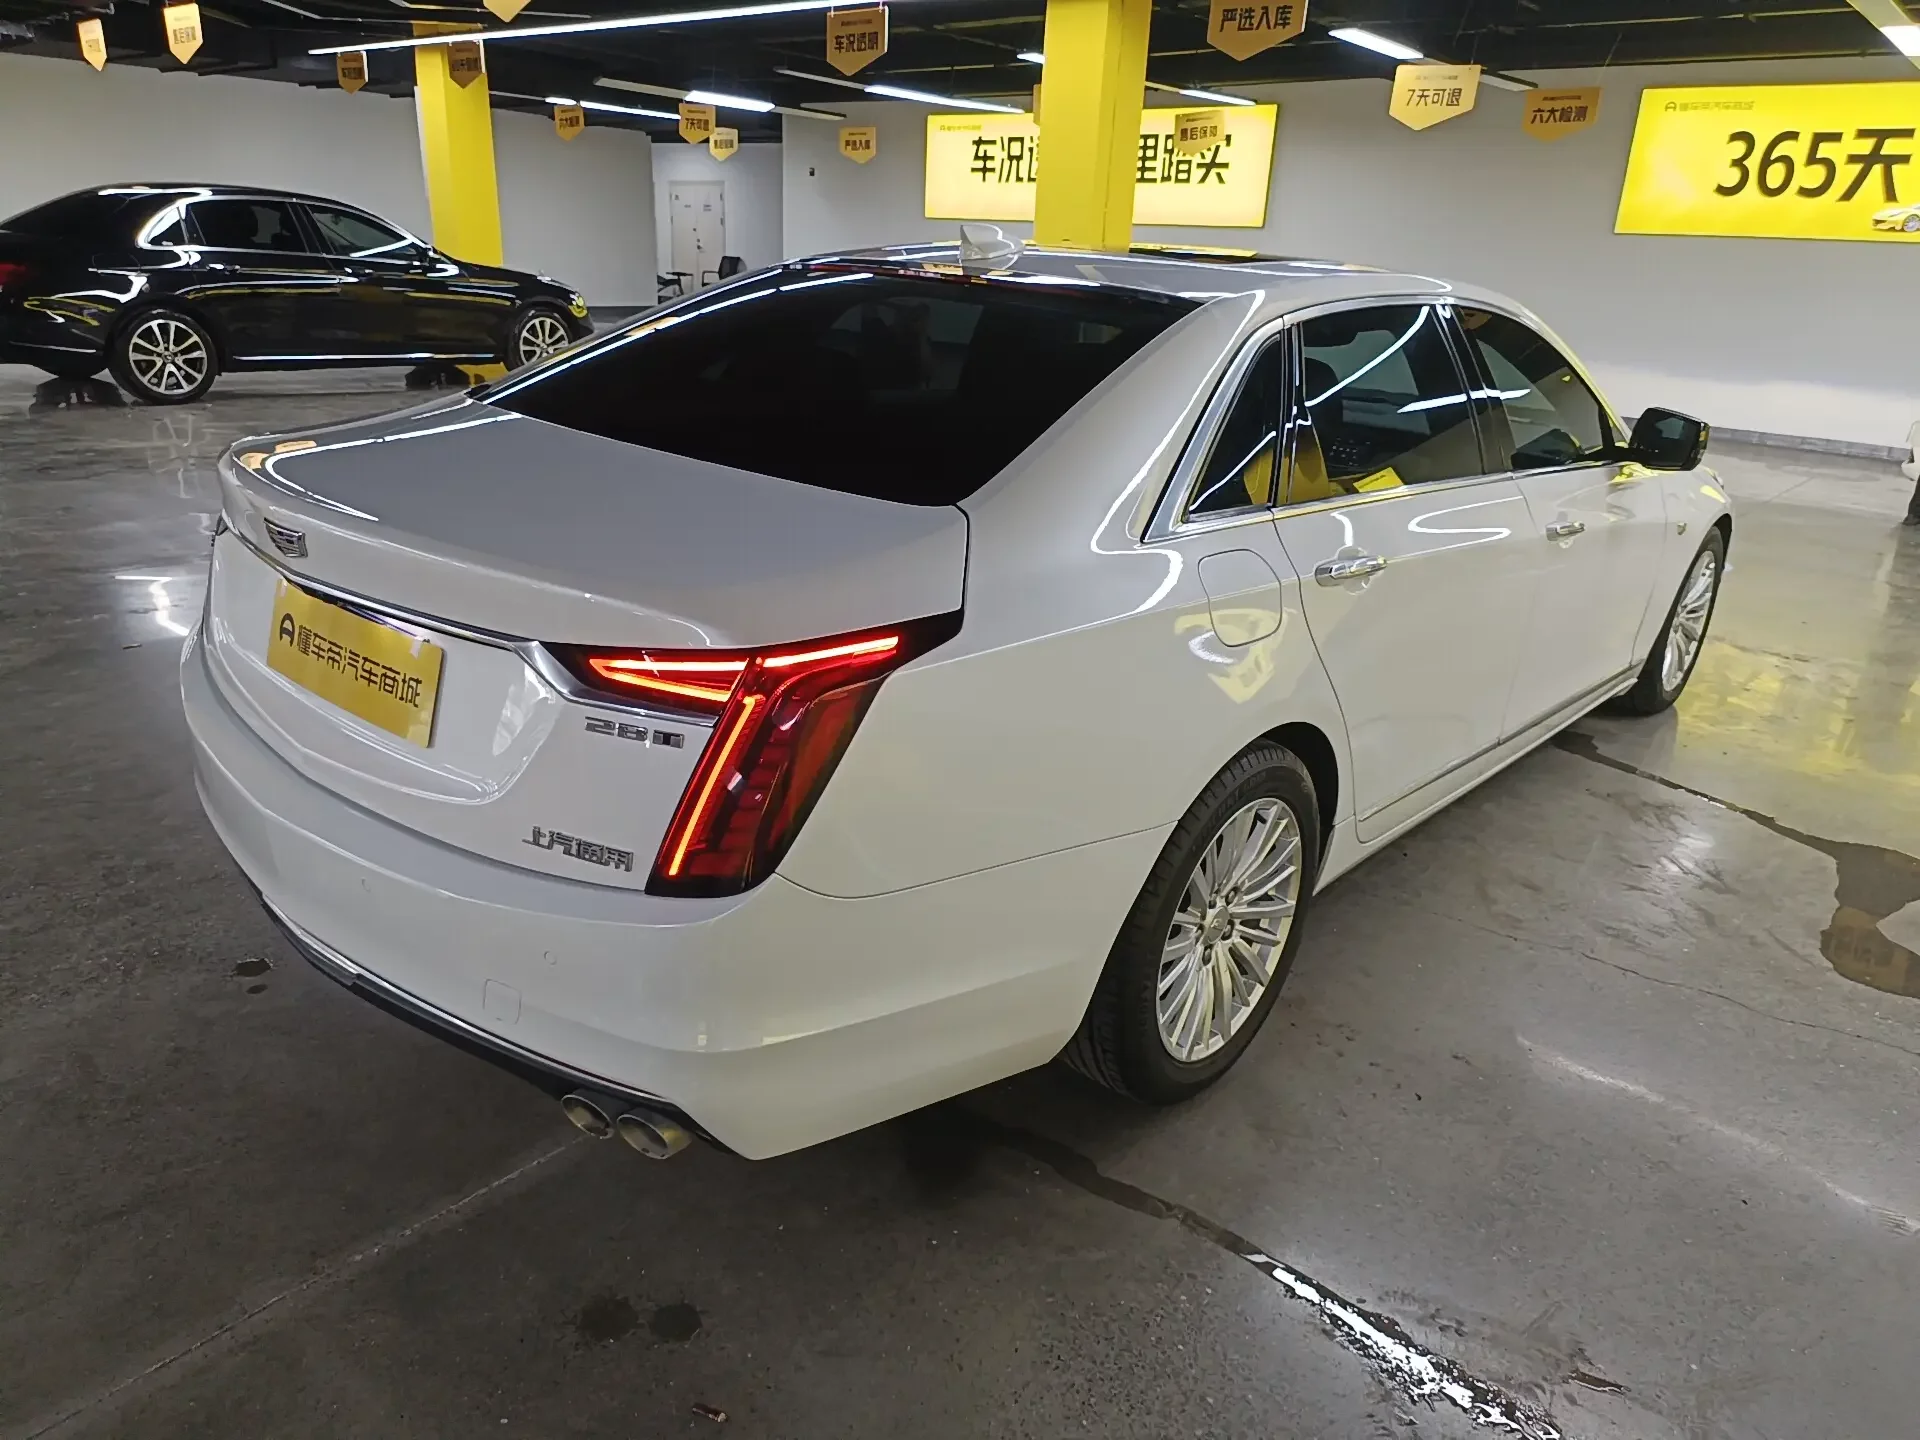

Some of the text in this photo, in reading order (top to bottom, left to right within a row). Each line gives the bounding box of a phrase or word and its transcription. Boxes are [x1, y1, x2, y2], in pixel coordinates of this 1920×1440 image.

[1219, 5, 1294, 33] 严选入库
[833, 31, 879, 54] 车况透明
[1405, 87, 1463, 107] 7天可退
[1530, 105, 1589, 125] 六大检测
[1712, 127, 1917, 204] 365天
[296, 624, 423, 709] 懂车帝汽车商城
[584, 716, 685, 749] 28T
[521, 826, 634, 872] 上汽通用
